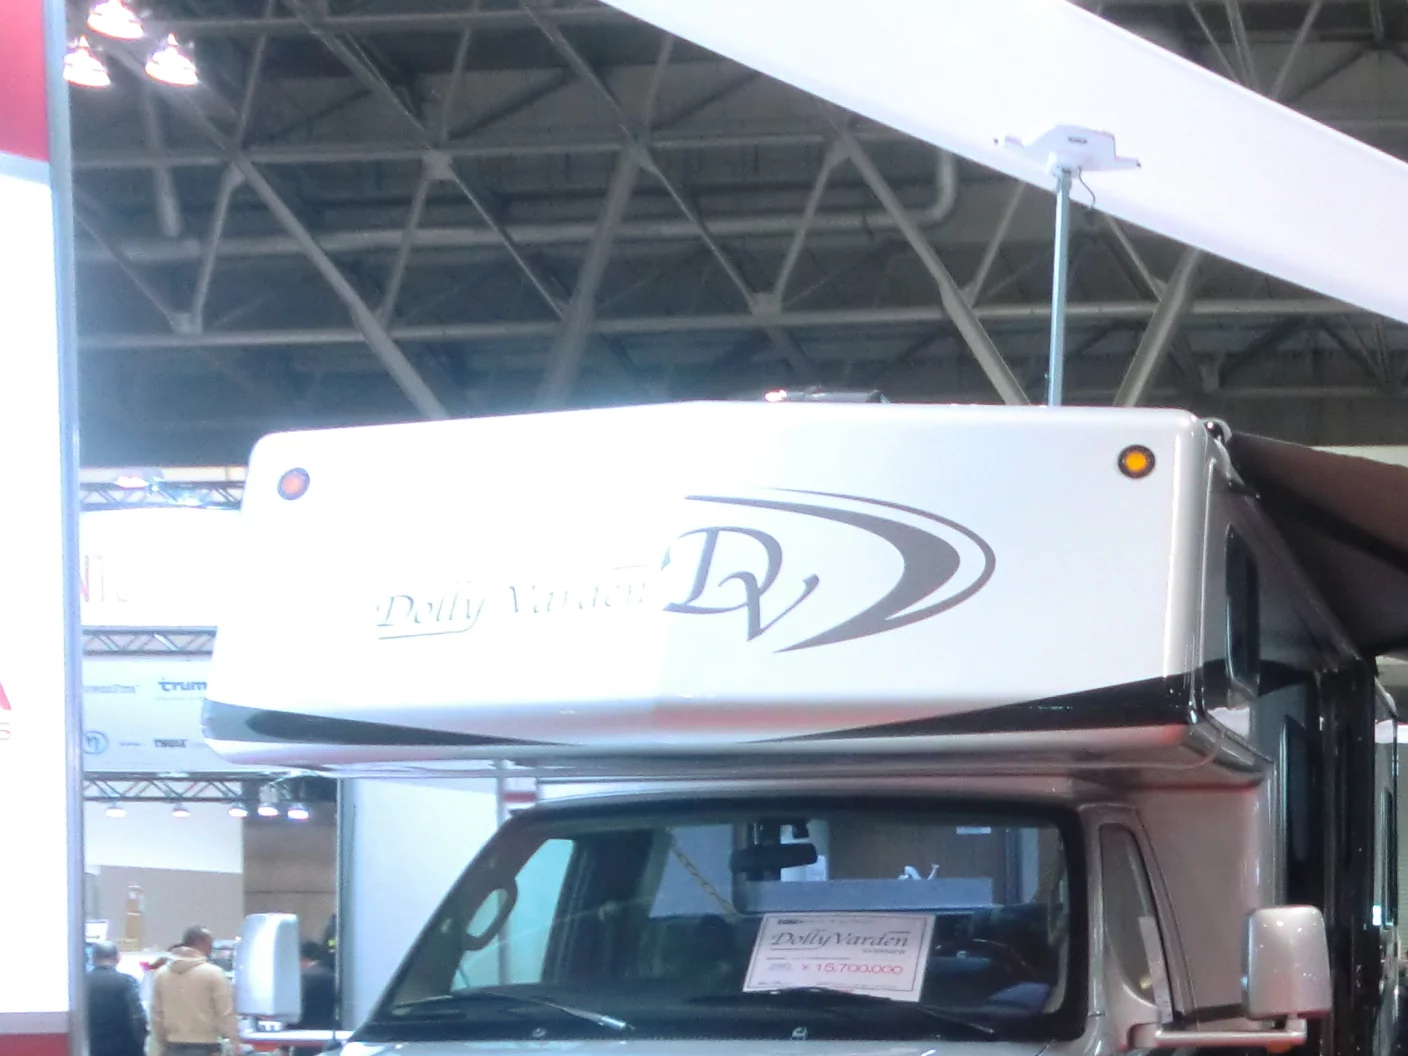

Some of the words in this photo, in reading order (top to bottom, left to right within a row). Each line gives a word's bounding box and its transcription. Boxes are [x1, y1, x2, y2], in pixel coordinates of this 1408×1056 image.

[375, 580, 486, 640] Dolly
[157, 678, 208, 692] trum
[770, 928, 832, 951] Dolly
[833, 930, 912, 948] Varden
